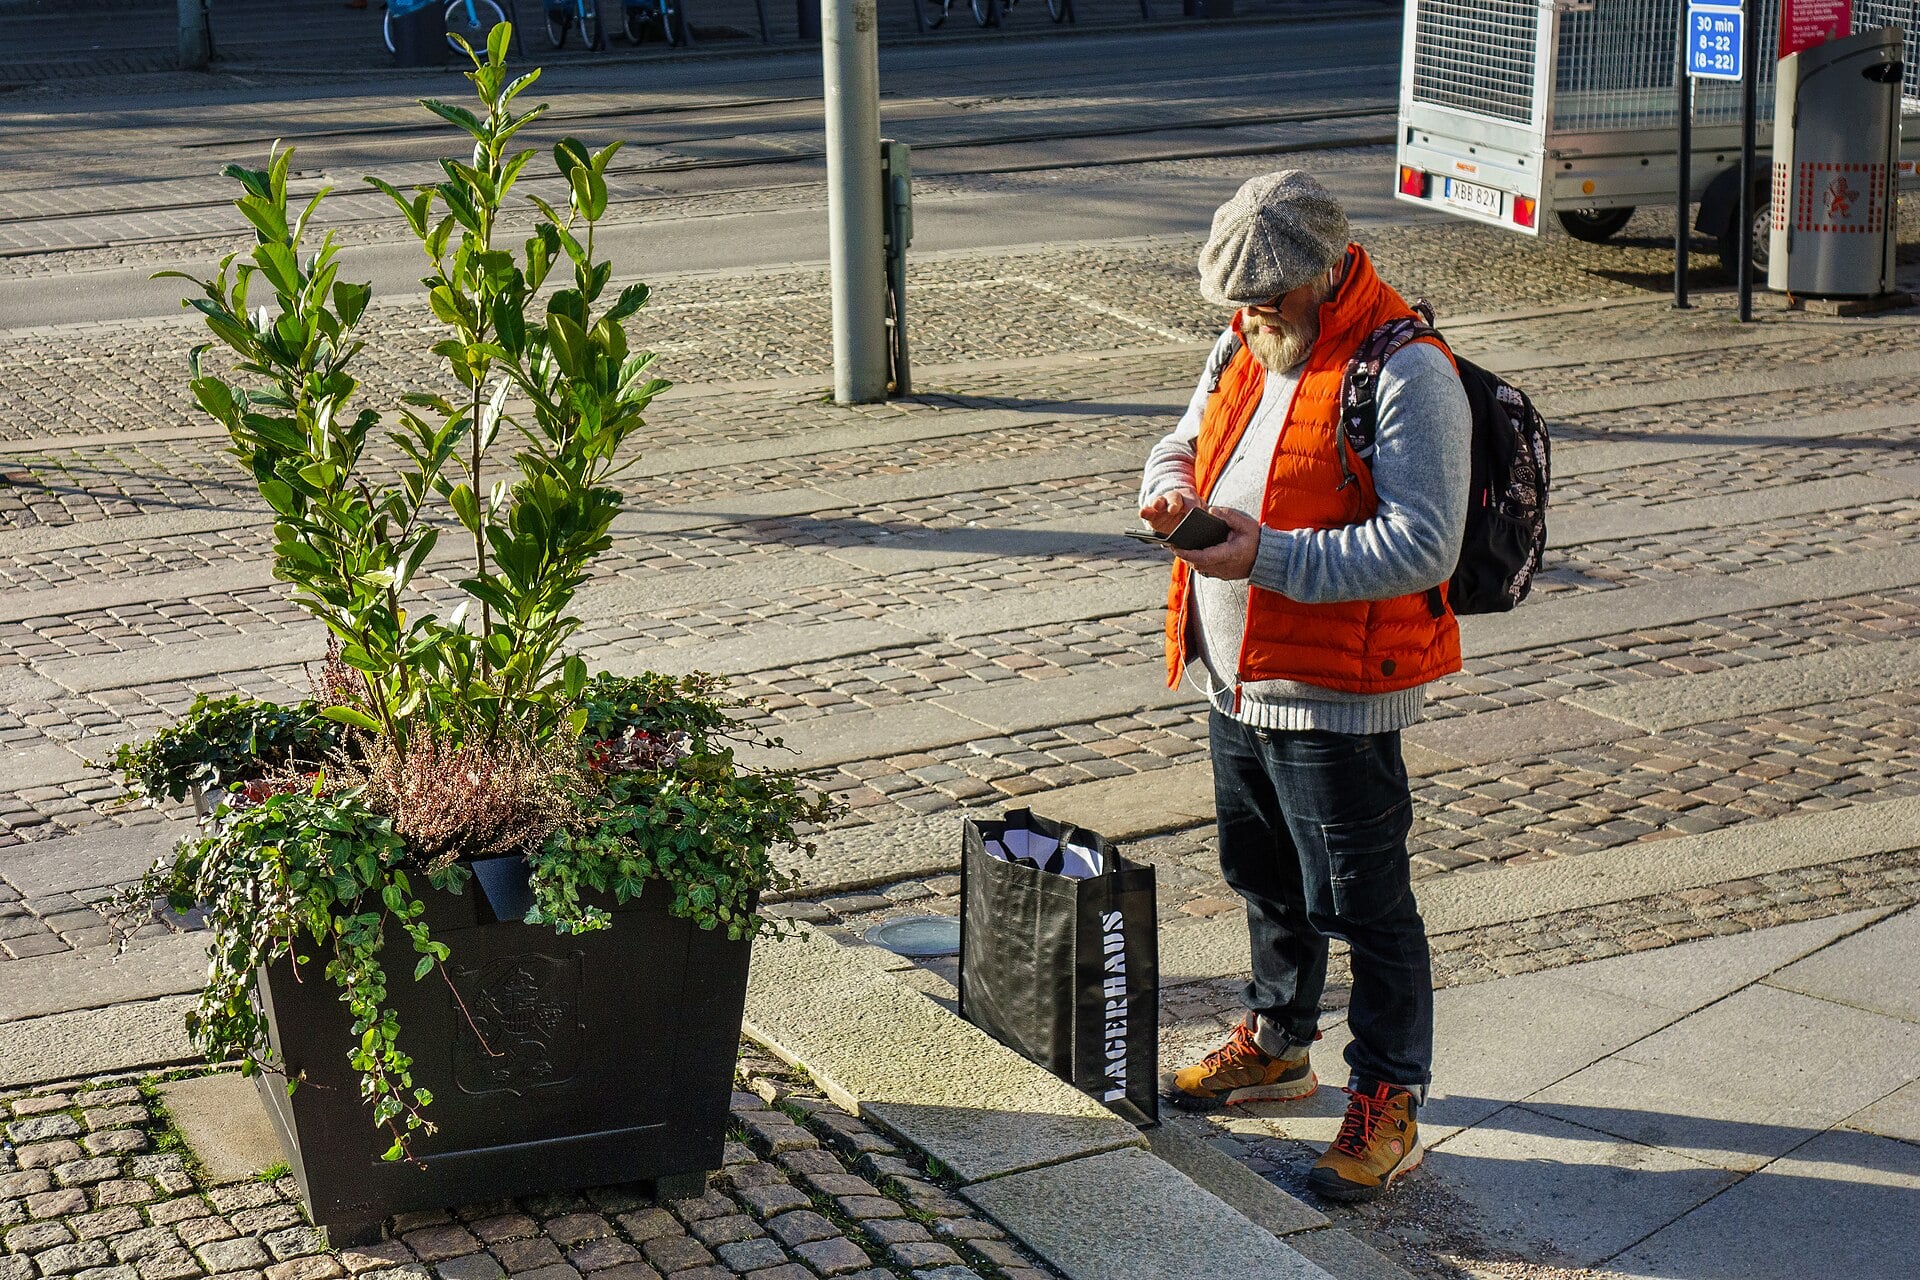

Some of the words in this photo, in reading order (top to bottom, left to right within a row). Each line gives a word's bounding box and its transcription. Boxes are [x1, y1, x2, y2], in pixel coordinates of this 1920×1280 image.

[1697, 16, 1712, 31] 30
[1715, 17, 1734, 33] min
[1454, 181, 1473, 201] XBB
[1103, 911, 1128, 1102] LAGERHAUS
